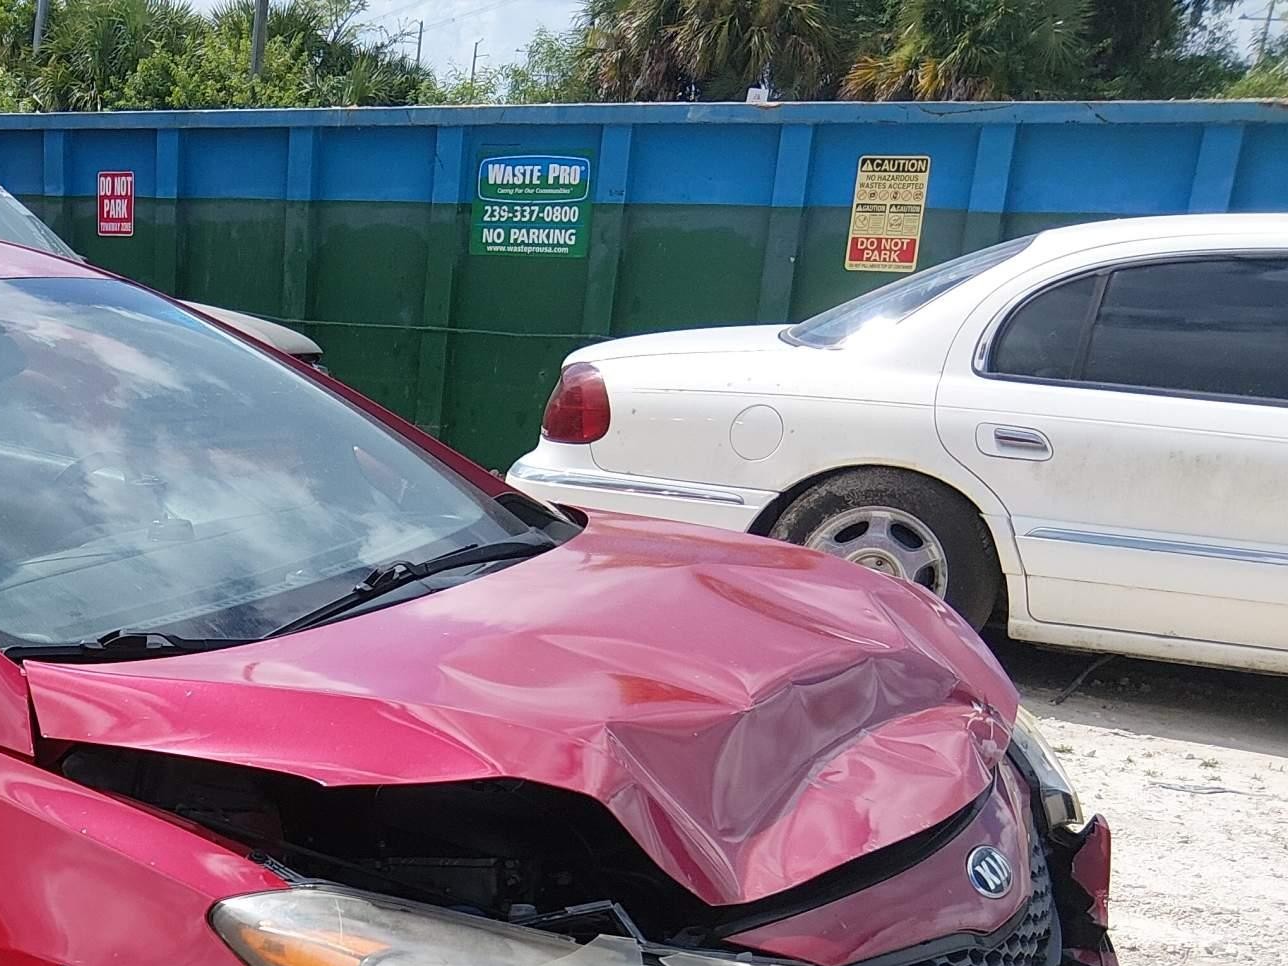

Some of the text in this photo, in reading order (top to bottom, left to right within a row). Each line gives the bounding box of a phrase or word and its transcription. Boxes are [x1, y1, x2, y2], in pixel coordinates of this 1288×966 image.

[873, 159, 927, 172] CAUTION
[487, 163, 542, 185] WASTE
[877, 174, 919, 182] HAZARDOUS
[100, 176, 132, 196] DO NOT
[887, 182, 924, 190] ACCEPTED
[103, 199, 128, 218] PARK
[483, 205, 579, 222] 239-337-0800
[482, 228, 577, 245] NO PARKING
[486, 245, 569, 254] www.wasteprousa.com
[857, 238, 911, 250] DO NOT
[863, 250, 901, 262] PARK
